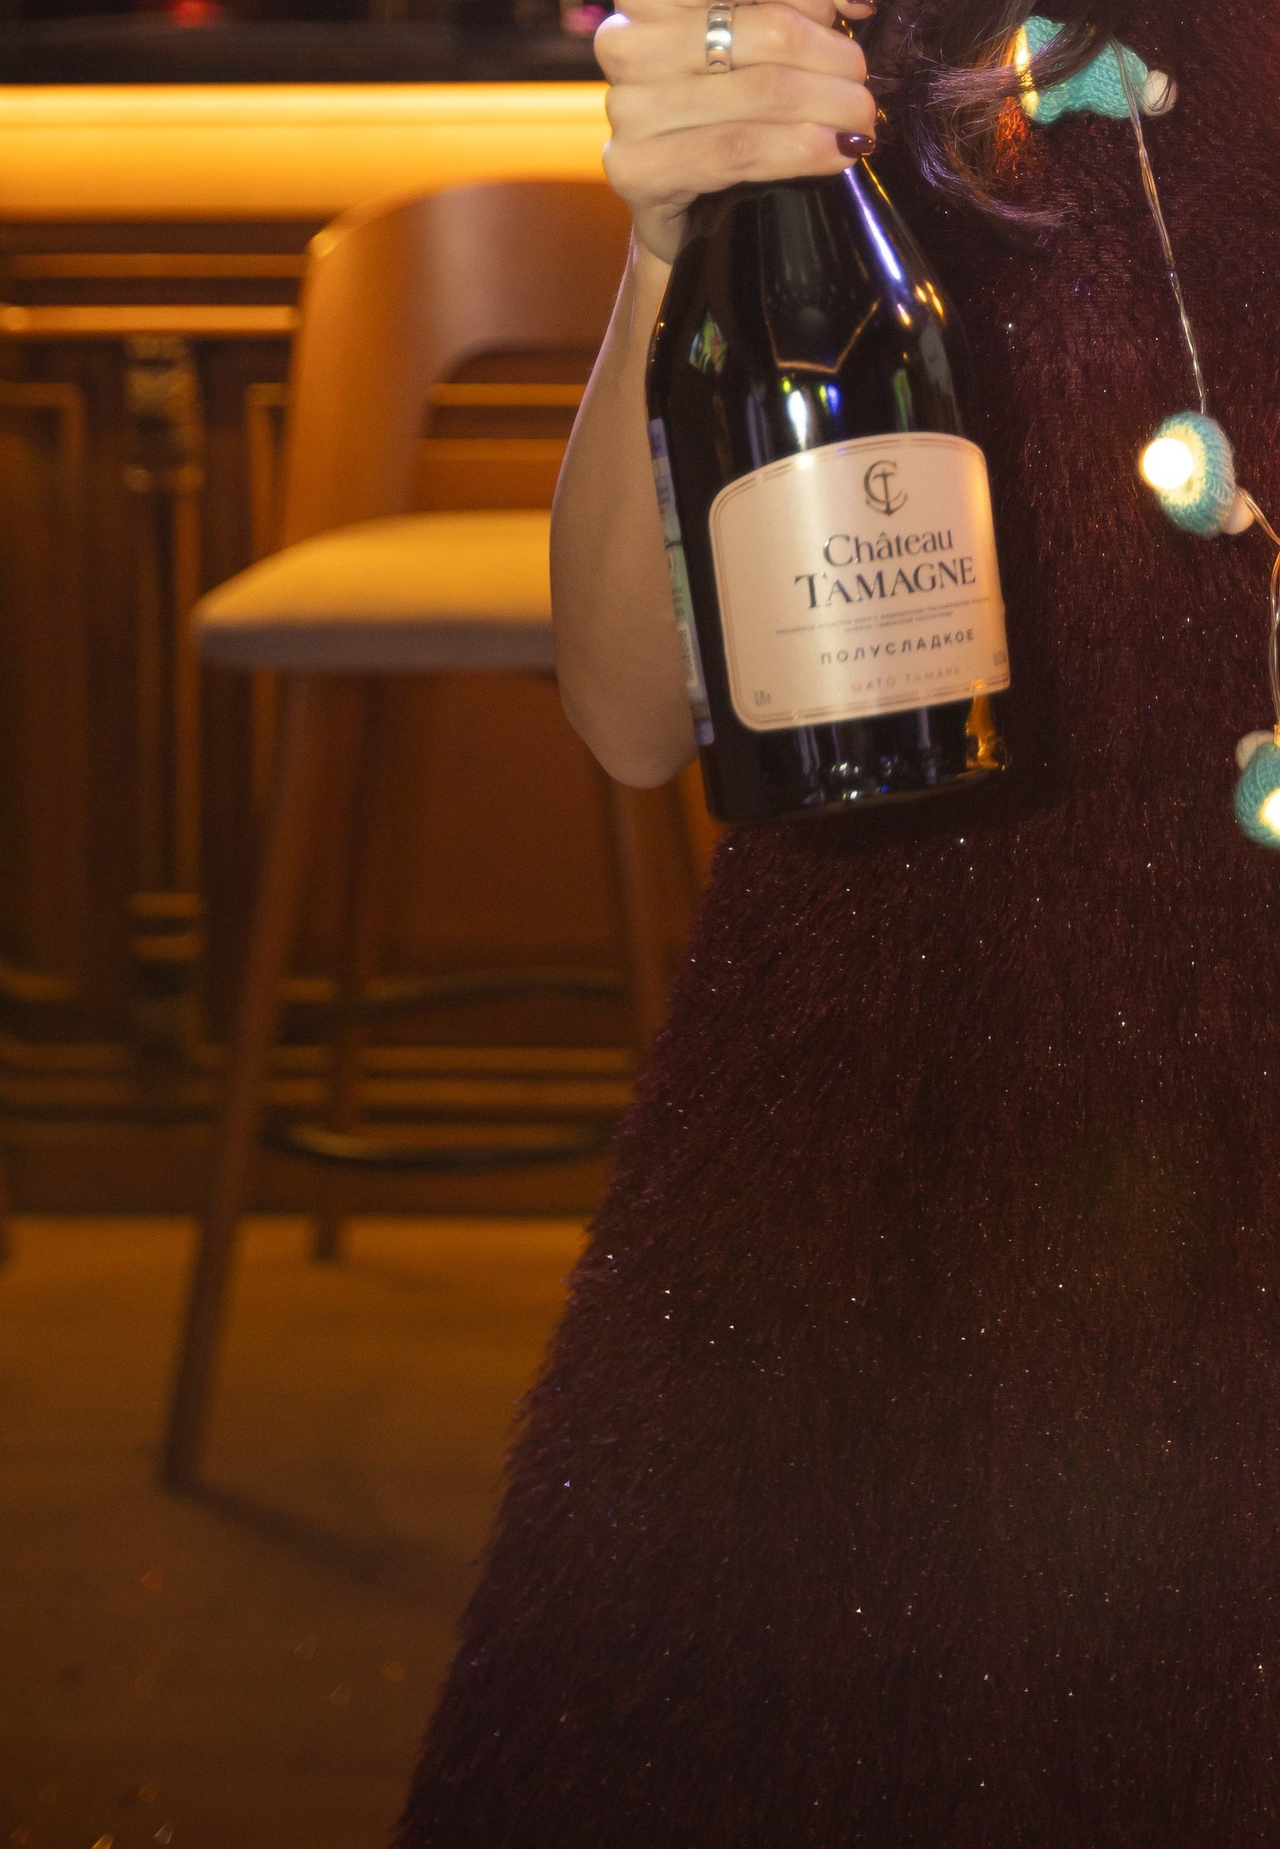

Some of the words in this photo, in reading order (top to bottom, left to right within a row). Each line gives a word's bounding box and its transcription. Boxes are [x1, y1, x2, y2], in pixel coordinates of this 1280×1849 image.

[823, 529, 953, 567] Château
[794, 556, 976, 609] TAMAGNE
[821, 628, 975, 665] ПОЛУСЛАДКОЕ
